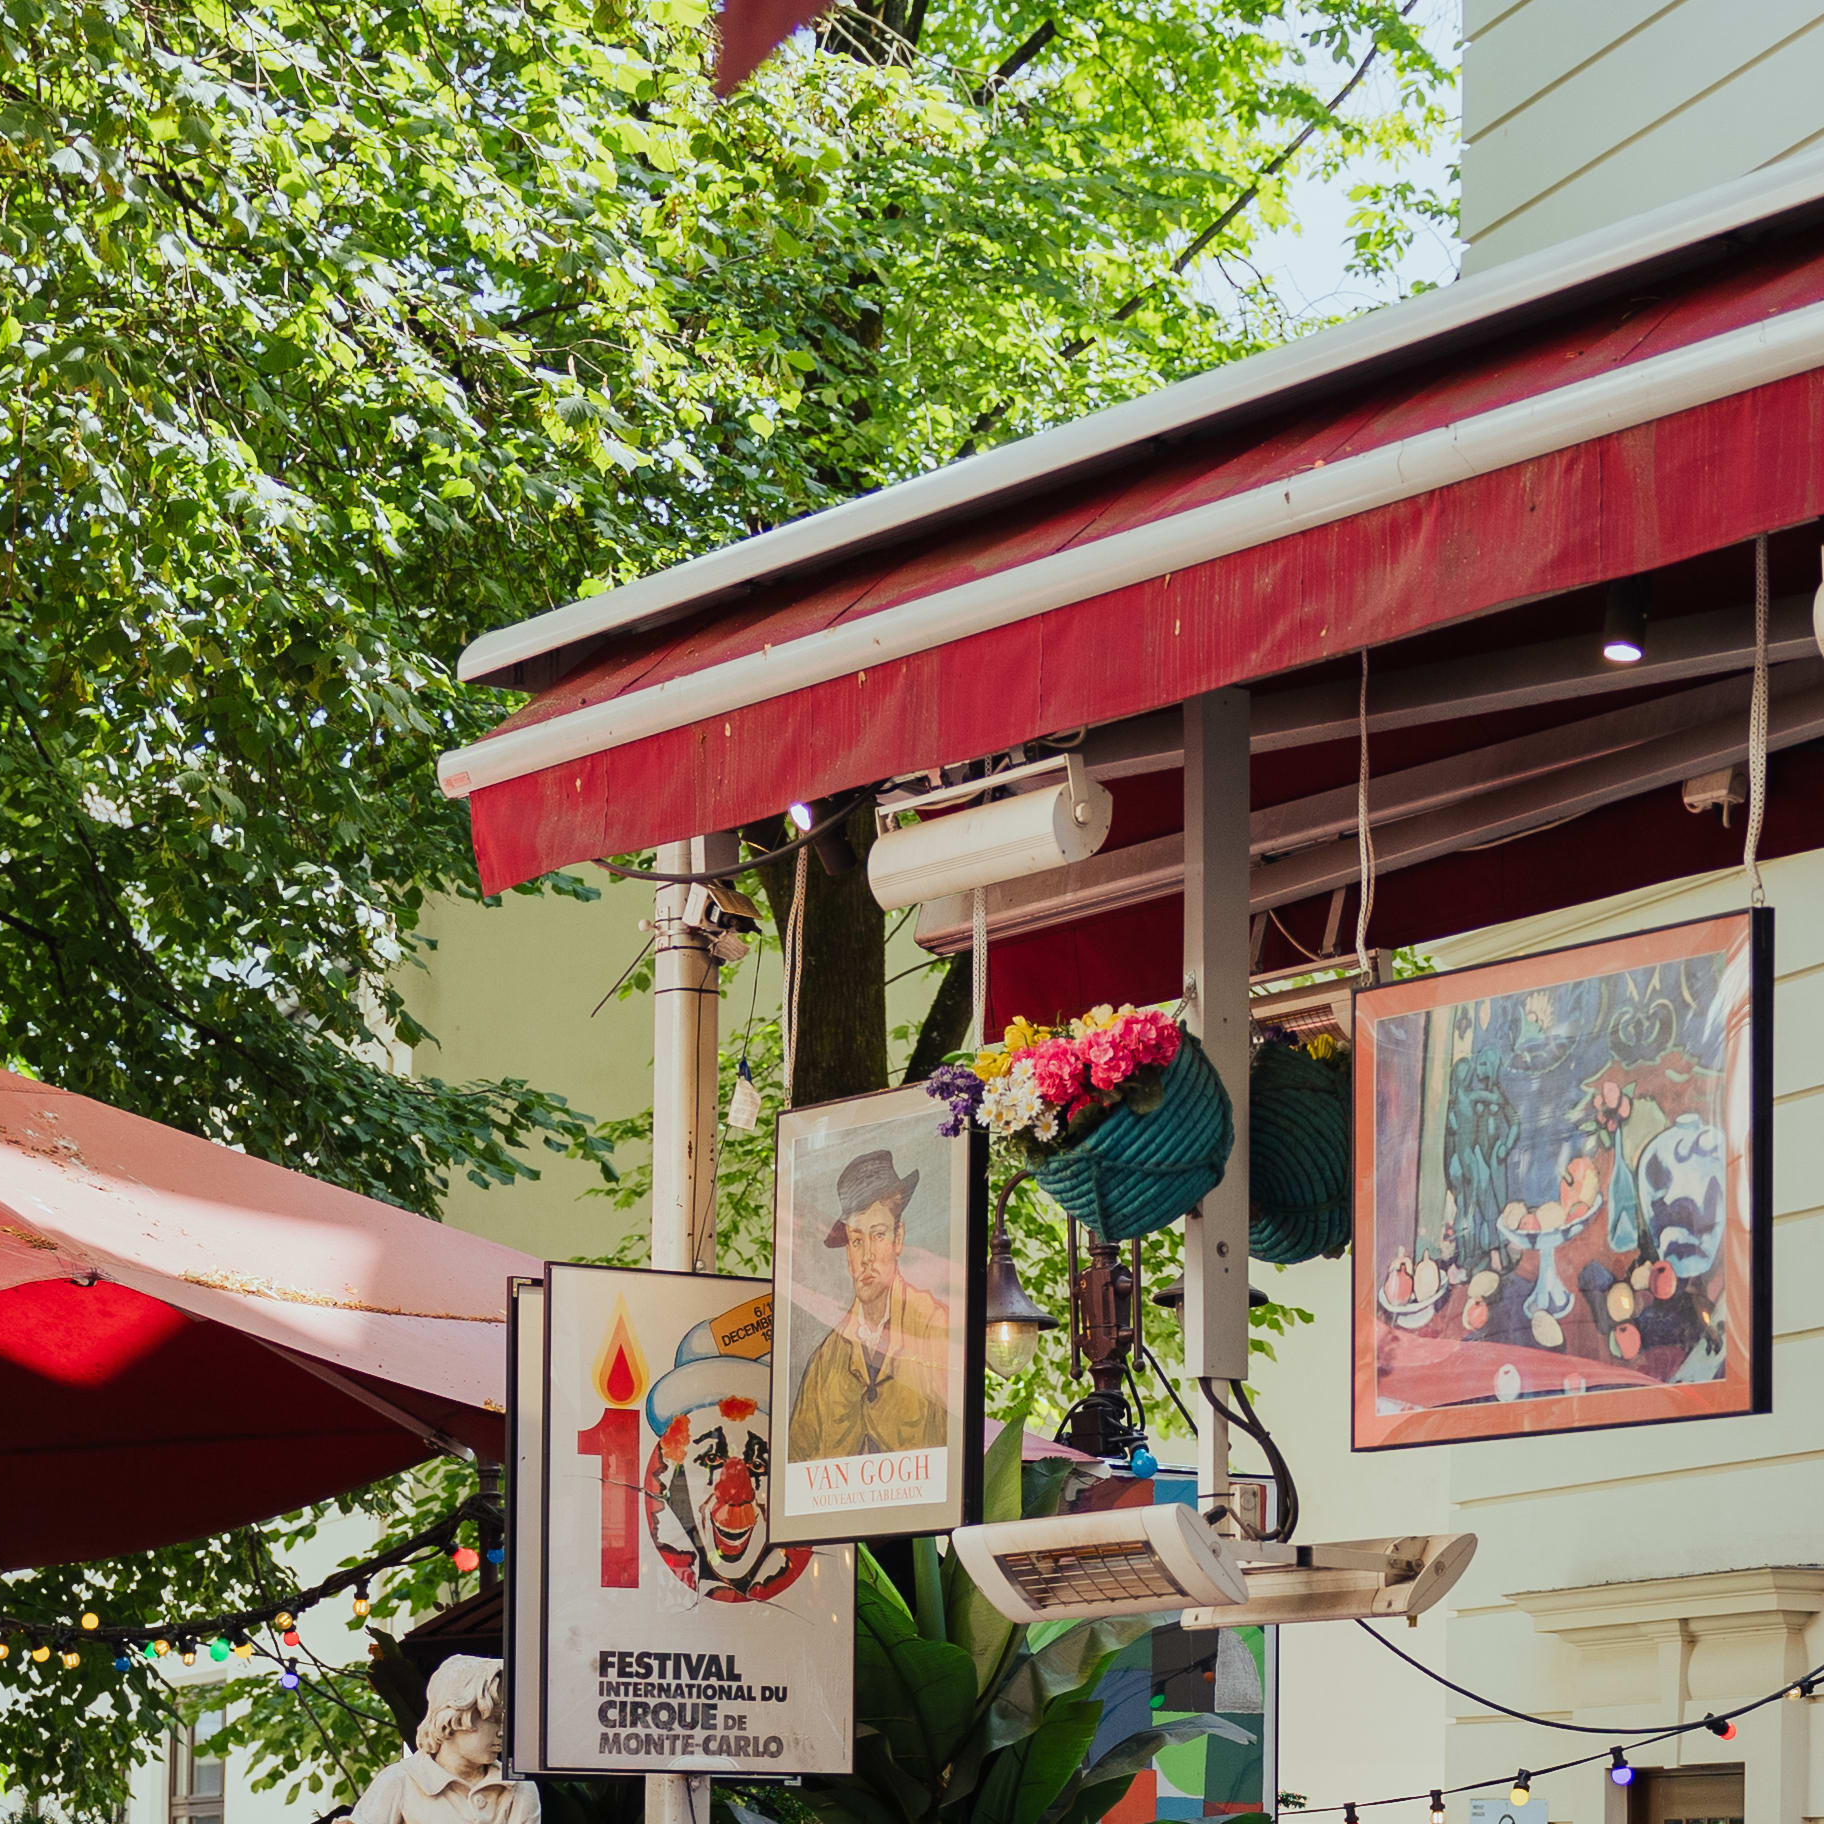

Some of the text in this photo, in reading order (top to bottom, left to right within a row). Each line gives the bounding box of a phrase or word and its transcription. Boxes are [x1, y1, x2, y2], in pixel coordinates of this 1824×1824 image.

[805, 1454, 930, 1490] VAN GOGH
[812, 1486, 923, 1508] NOUVEAUX TABLEAUX
[598, 1650, 742, 1682] FESTIVAL
[598, 1681, 787, 1702] INTERNATIONAL DU
[597, 1700, 747, 1732] CIRQUE DE
[598, 1732, 784, 1758] MONTE-CARLO
